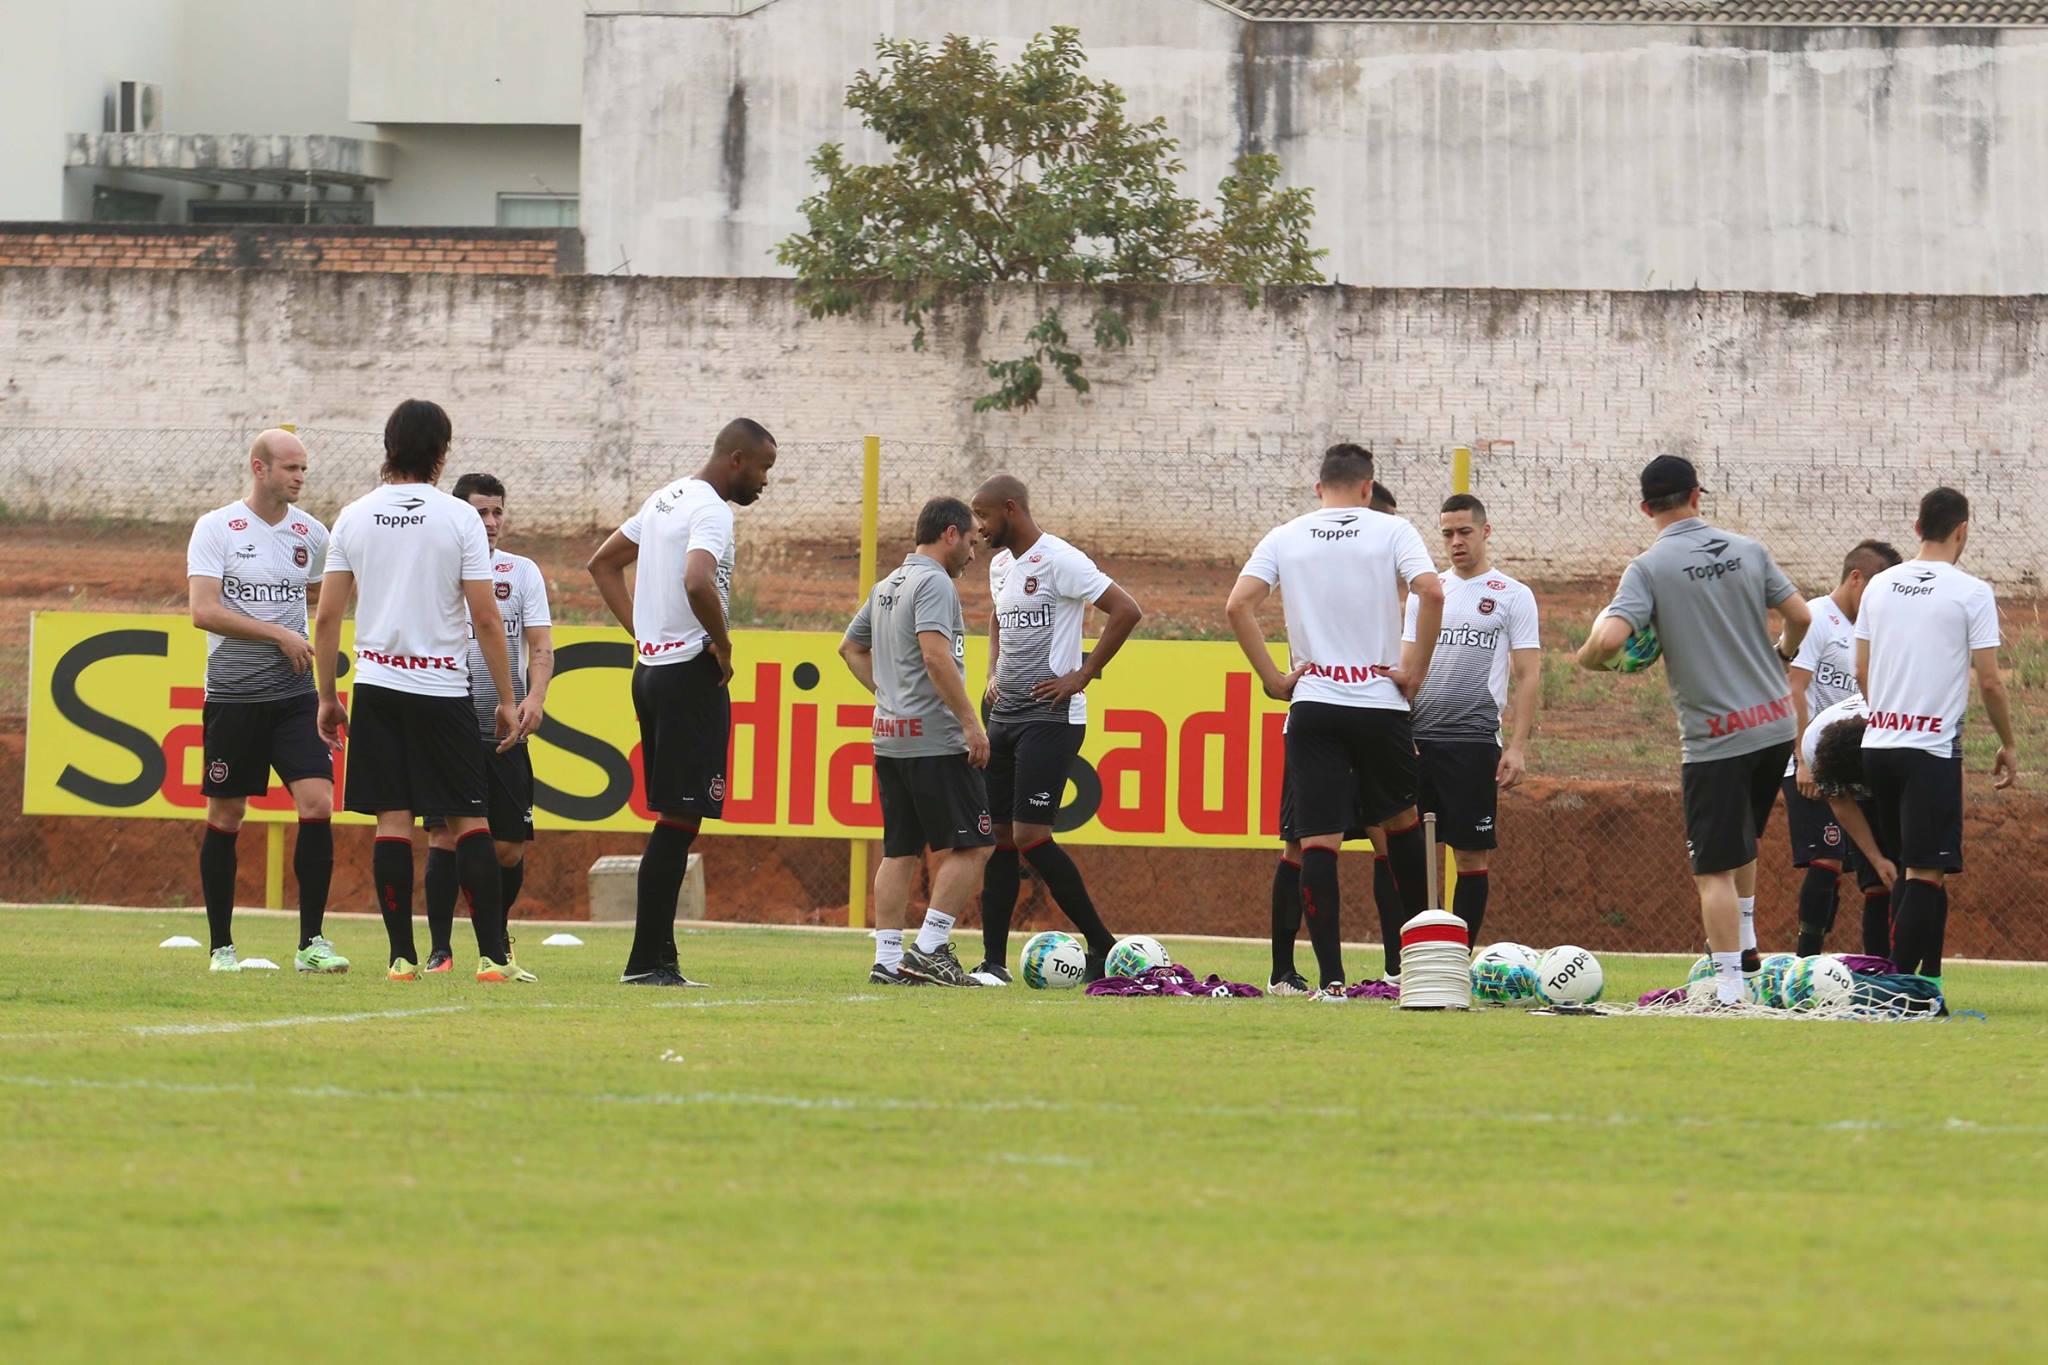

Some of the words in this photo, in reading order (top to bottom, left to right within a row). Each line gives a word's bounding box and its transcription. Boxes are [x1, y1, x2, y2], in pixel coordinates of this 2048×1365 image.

[373, 513, 427, 528] Topper
[1310, 528, 1360, 541] Topper
[1682, 557, 1742, 582] Topper
[1892, 582, 1935, 596] Topper
[1000, 603, 1051, 629] nrisul
[1438, 622, 1499, 651] nrisul
[1867, 711, 1943, 733] AVANTE
[1028, 798, 1051, 807] Topper
[1053, 958, 1087, 981] Topp
[1548, 951, 1590, 990] Toppe
